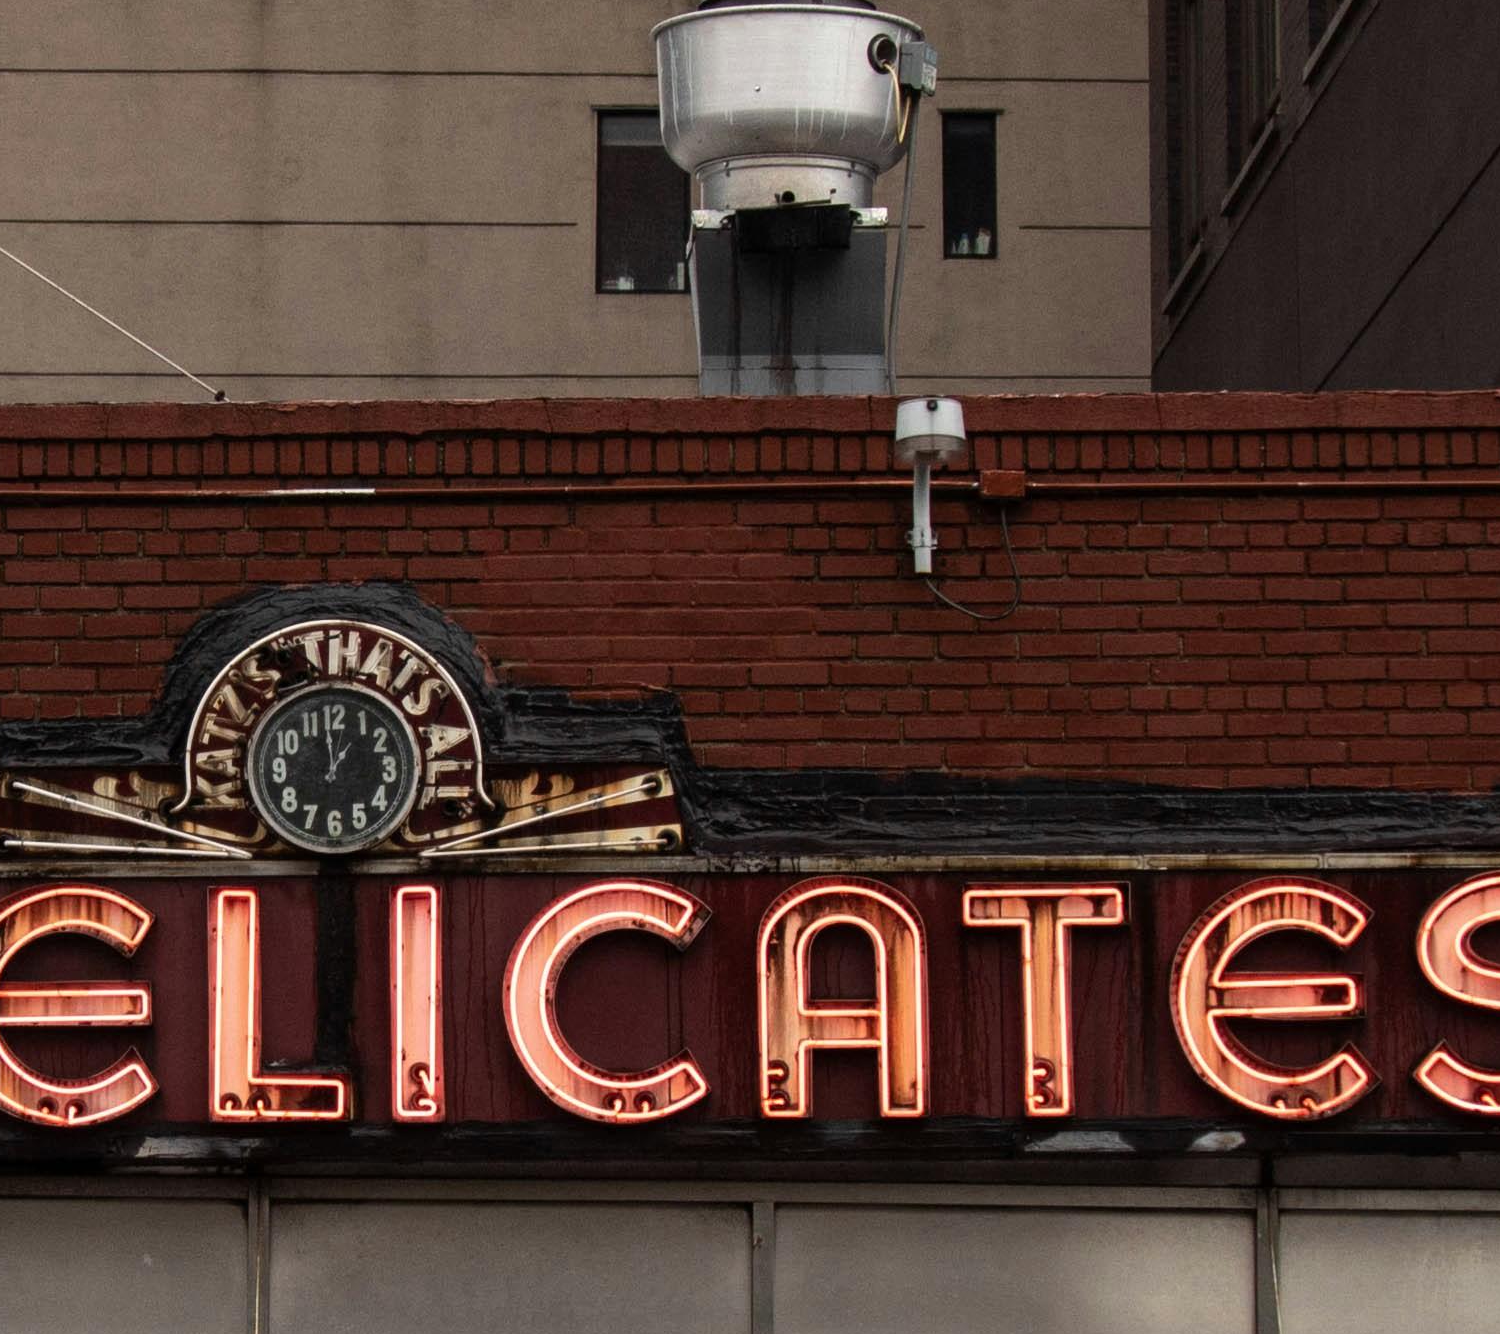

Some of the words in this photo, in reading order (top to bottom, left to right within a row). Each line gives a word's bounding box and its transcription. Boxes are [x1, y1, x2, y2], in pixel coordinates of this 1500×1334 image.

[303, 712, 318, 737] 11
[323, 704, 345, 730] 12
[358, 711, 366, 735] 1
[277, 729, 299, 755] 10
[373, 727, 387, 754] 2
[272, 758, 286, 784] 9
[382, 756, 396, 783] 3
[281, 787, 298, 813] 8
[371, 785, 387, 811] 4
[303, 804, 318, 829] 7
[327, 810, 342, 837] 6
[352, 803, 367, 829] 5
